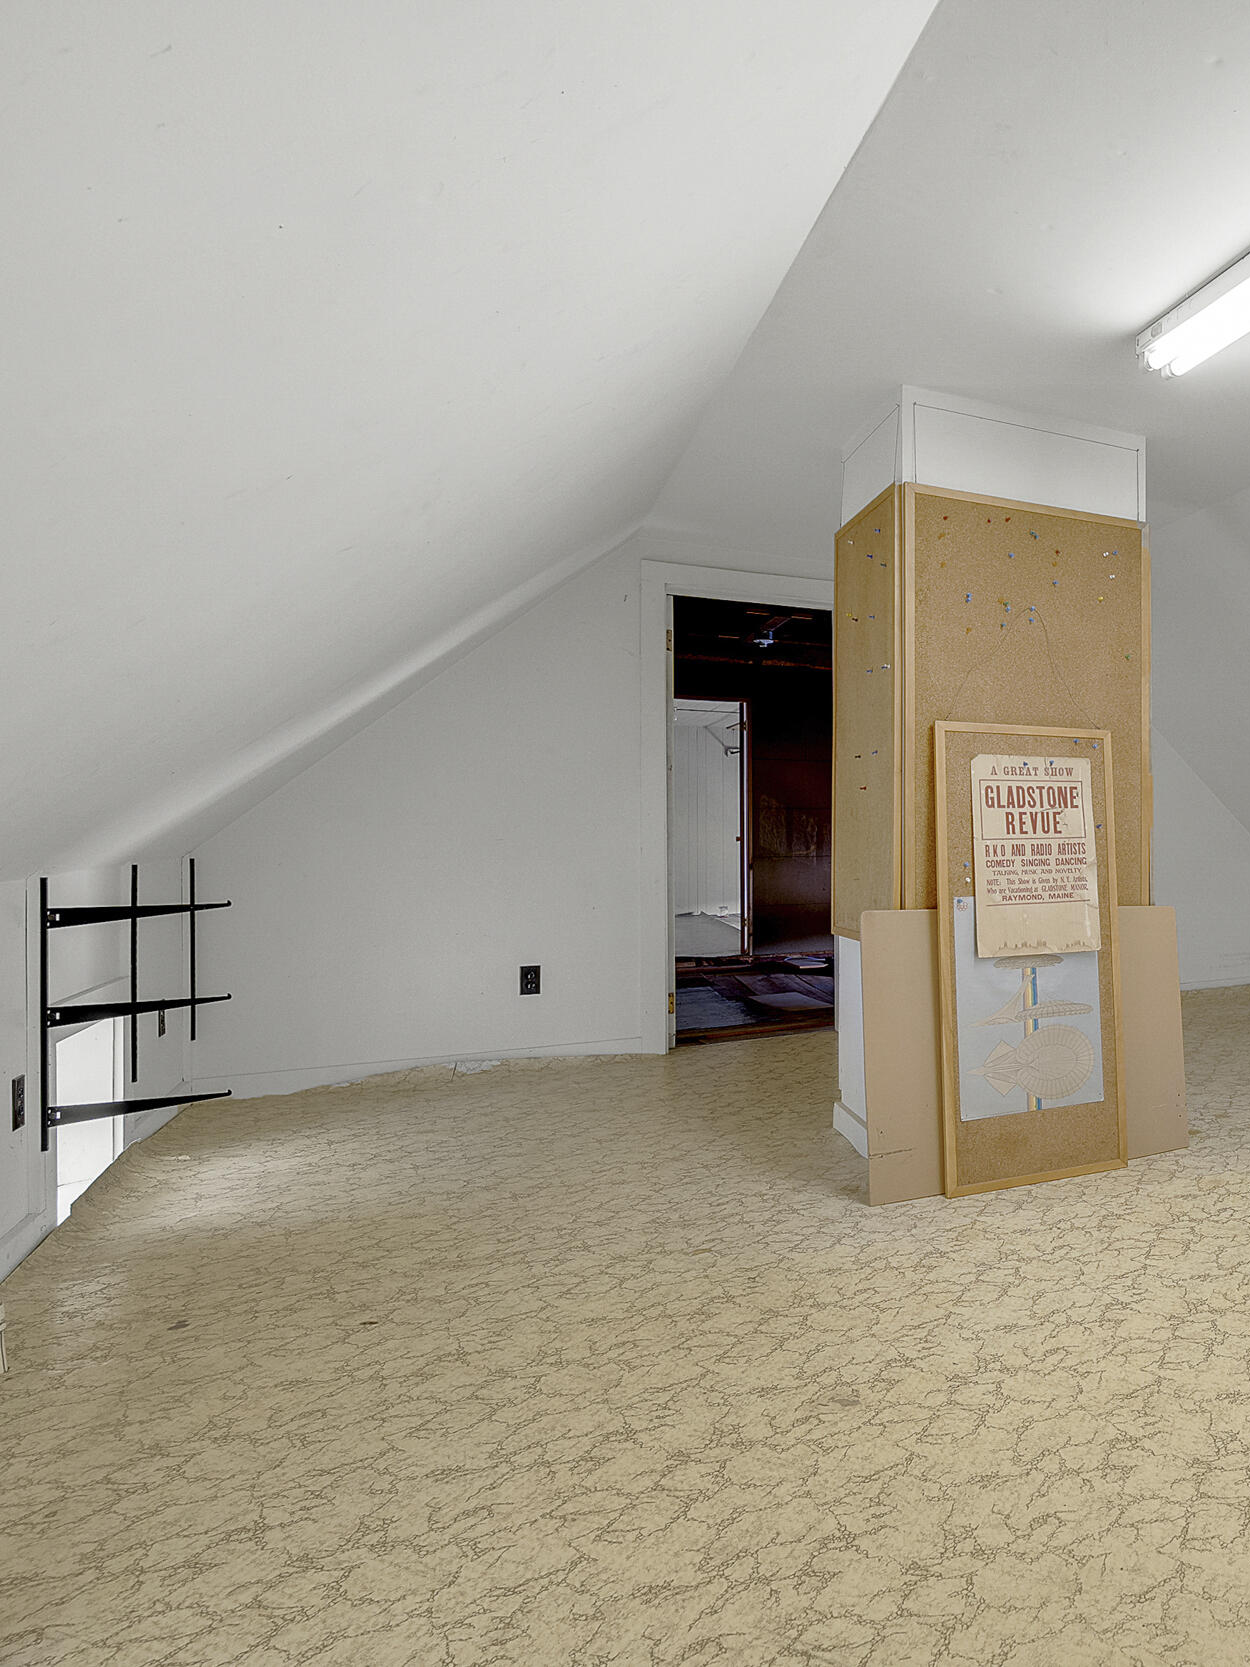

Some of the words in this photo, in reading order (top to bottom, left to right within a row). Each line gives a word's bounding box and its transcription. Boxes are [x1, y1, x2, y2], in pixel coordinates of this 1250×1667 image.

[991, 766, 998, 775] A
[1003, 766, 1039, 776] GREAT
[1044, 767, 1073, 776] SHOW
[984, 785, 1079, 808] GLADSTONE
[1005, 812, 1062, 834] REVUE
[985, 845, 990, 857] R
[993, 845, 998, 857] K
[1001, 844, 1005, 856] O
[1012, 844, 1025, 856] AND
[1031, 843, 1052, 856] RADIO
[1058, 843, 1086, 855] ARTISTS
[986, 859, 1015, 868] COMEDY
[1021, 858, 1050, 867] SINGING
[1055, 857, 1087, 866] DANCING
[1008, 886, 1033, 894] Vacationing
[1001, 894, 1045, 902] RAYMOND,
